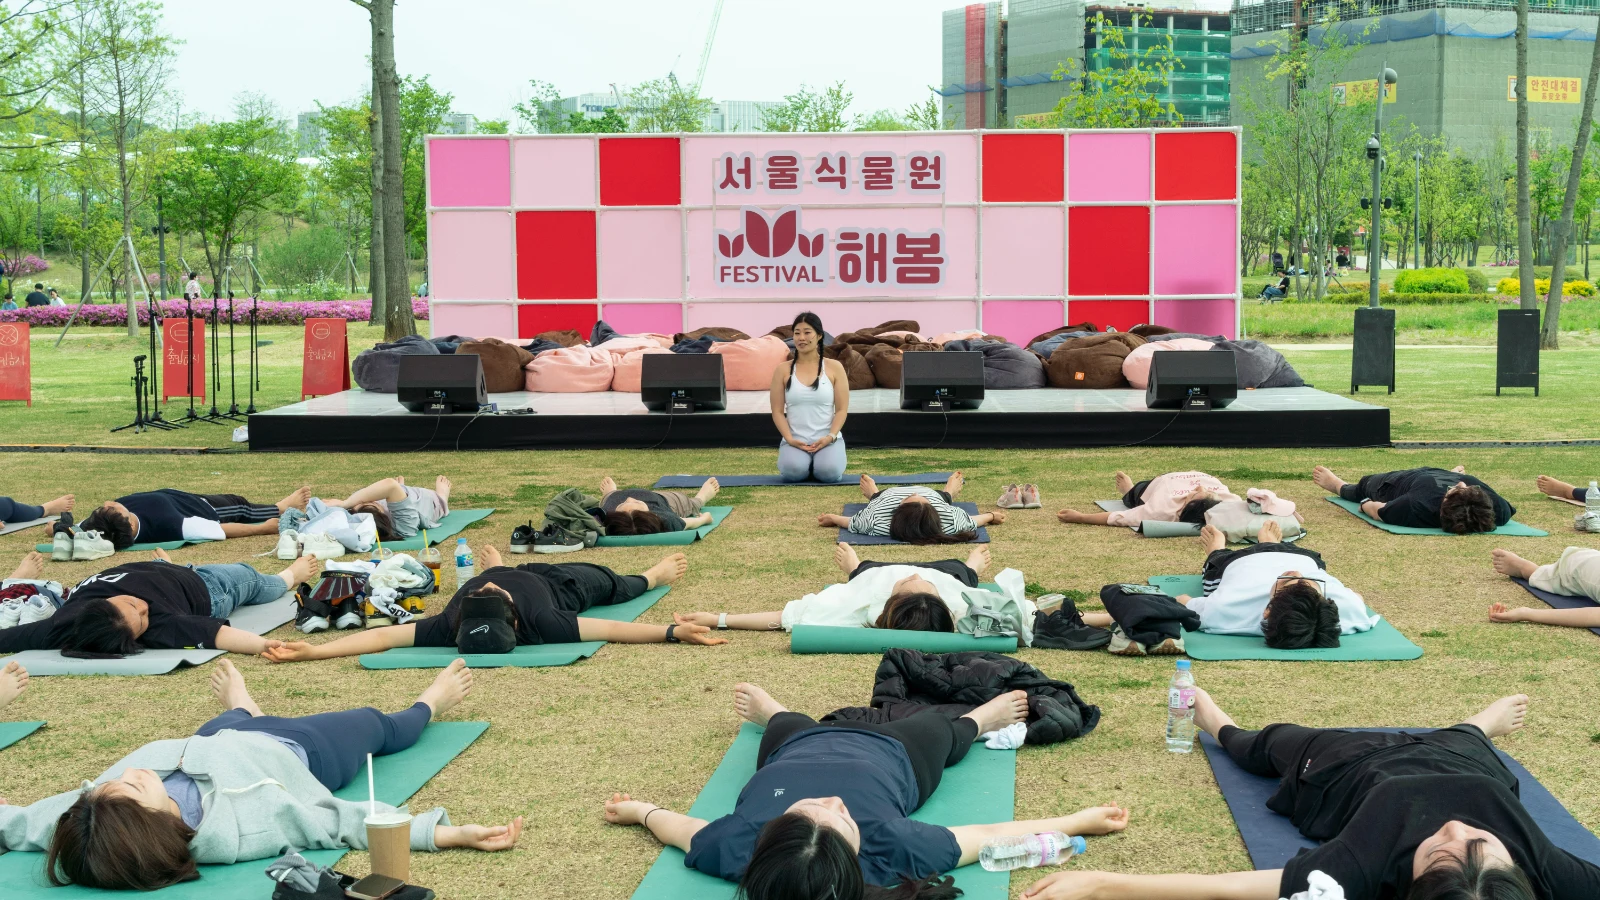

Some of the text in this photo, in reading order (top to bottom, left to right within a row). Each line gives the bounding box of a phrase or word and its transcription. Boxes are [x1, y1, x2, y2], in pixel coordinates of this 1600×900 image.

[1531, 80, 1578, 92] 안전대체결
[719, 155, 941, 191] 서울식물원
[836, 231, 945, 284] 해봄
[720, 265, 824, 283] FESTIVAL
